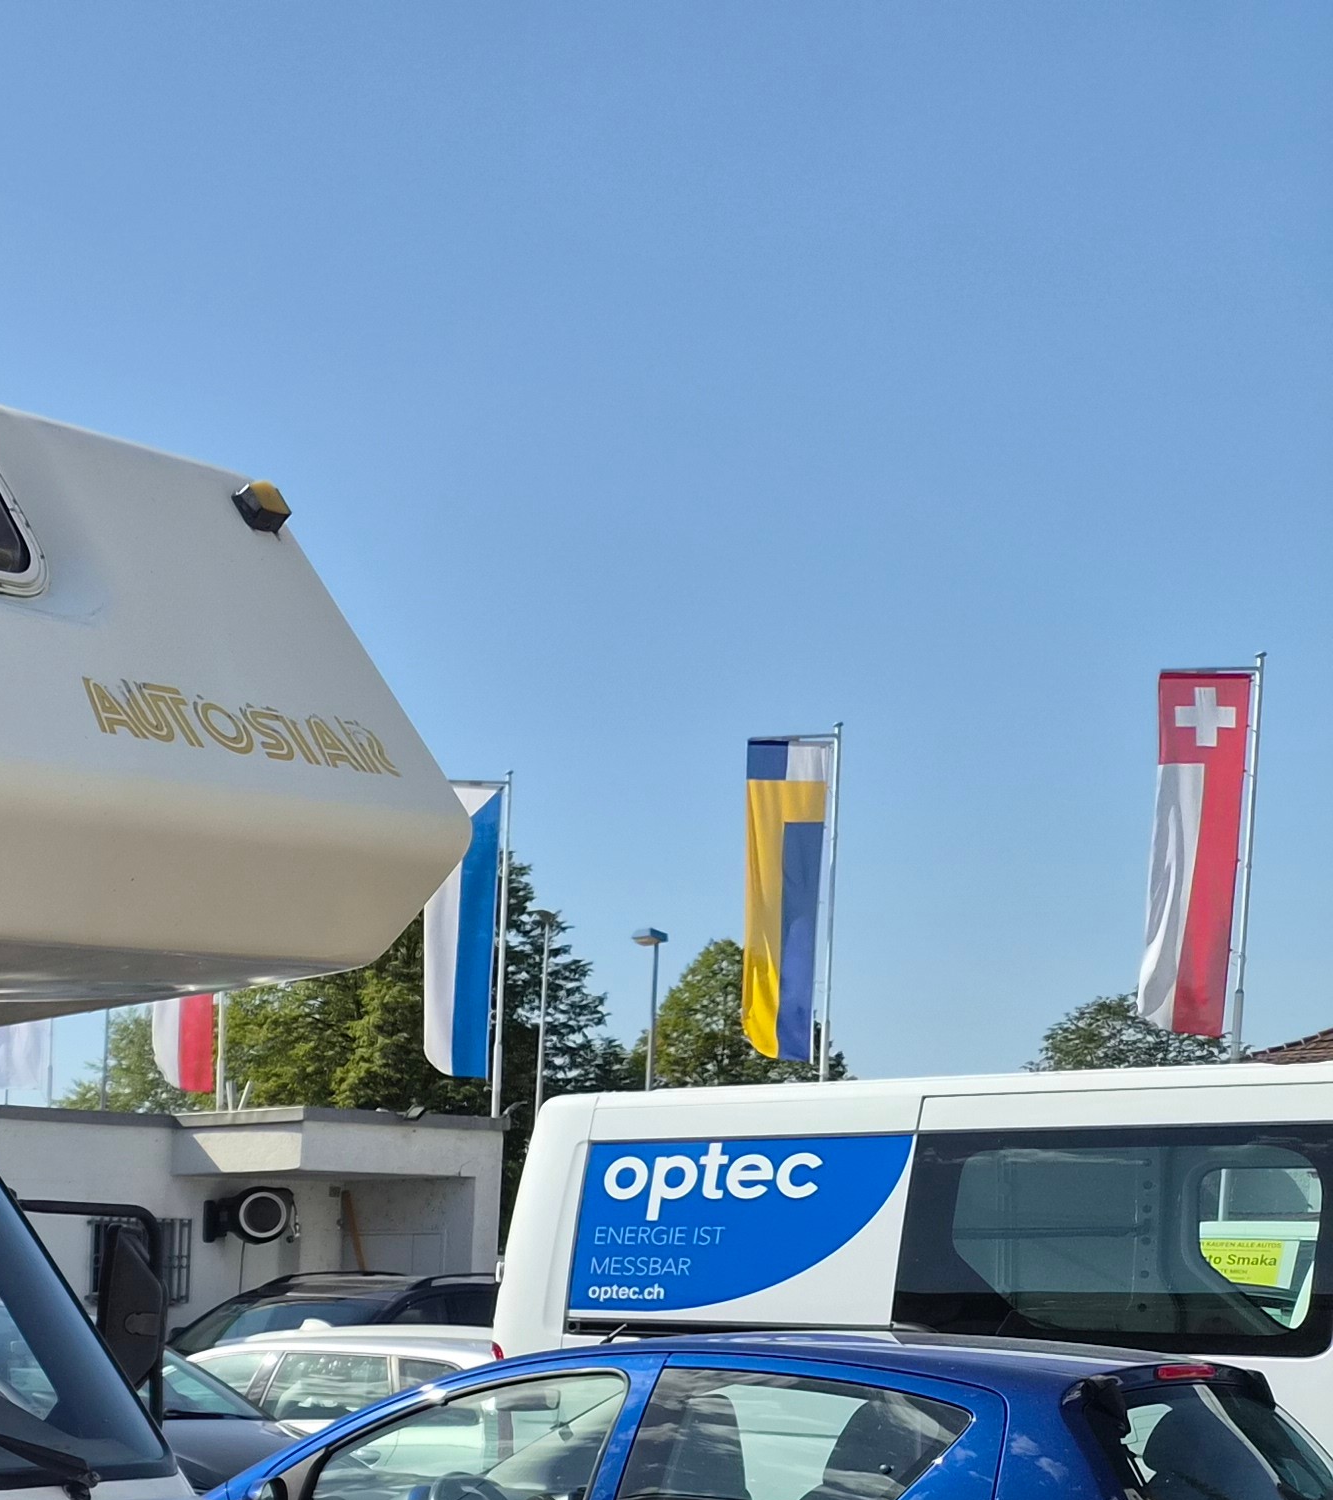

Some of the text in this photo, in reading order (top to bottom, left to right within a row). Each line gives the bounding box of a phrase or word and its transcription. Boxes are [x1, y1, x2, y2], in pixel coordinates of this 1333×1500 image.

[603, 1143, 823, 1221] optec
[594, 1226, 726, 1246] ENERGIE IST
[590, 1257, 692, 1277] MESSBAR
[1206, 1253, 1278, 1266] to Smaka
[588, 1283, 665, 1302] optec.ch
